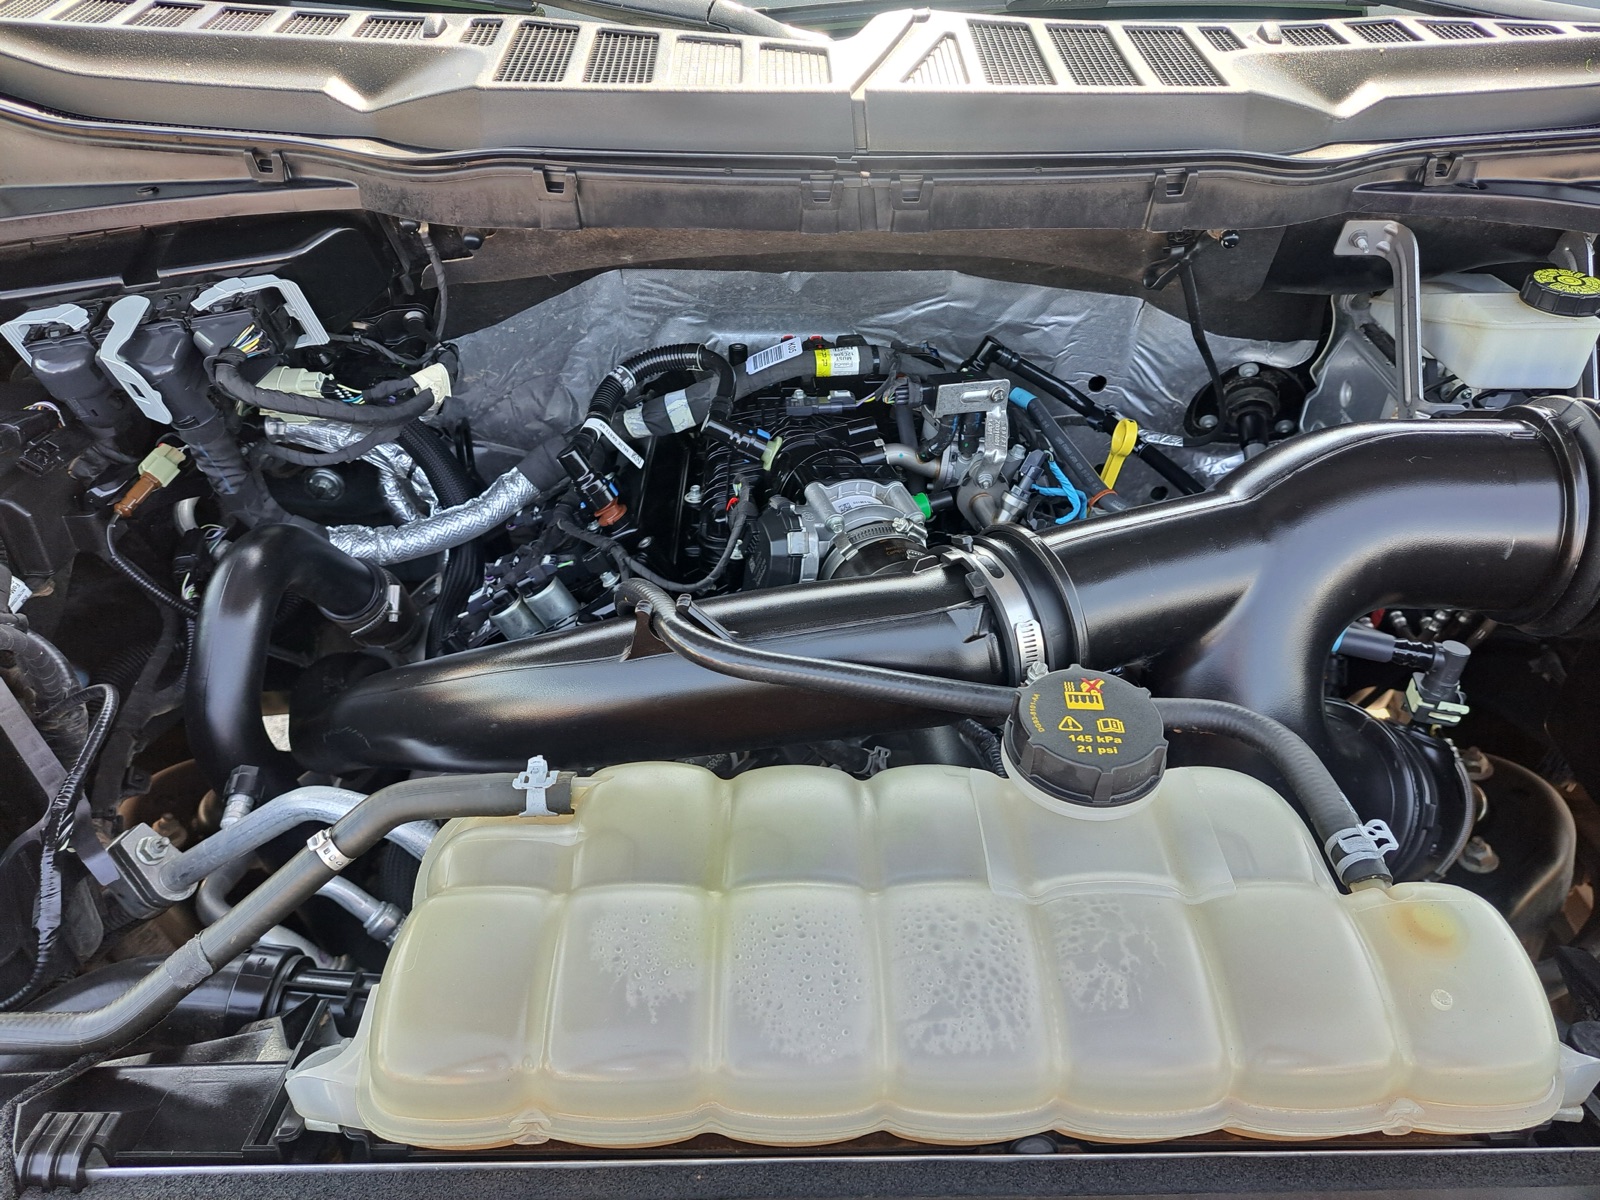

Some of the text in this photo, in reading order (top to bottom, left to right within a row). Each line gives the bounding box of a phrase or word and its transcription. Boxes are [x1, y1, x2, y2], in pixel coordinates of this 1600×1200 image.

[1068, 734, 1123, 744] 145 kPa
[1076, 745, 1118, 755] 21 psi
